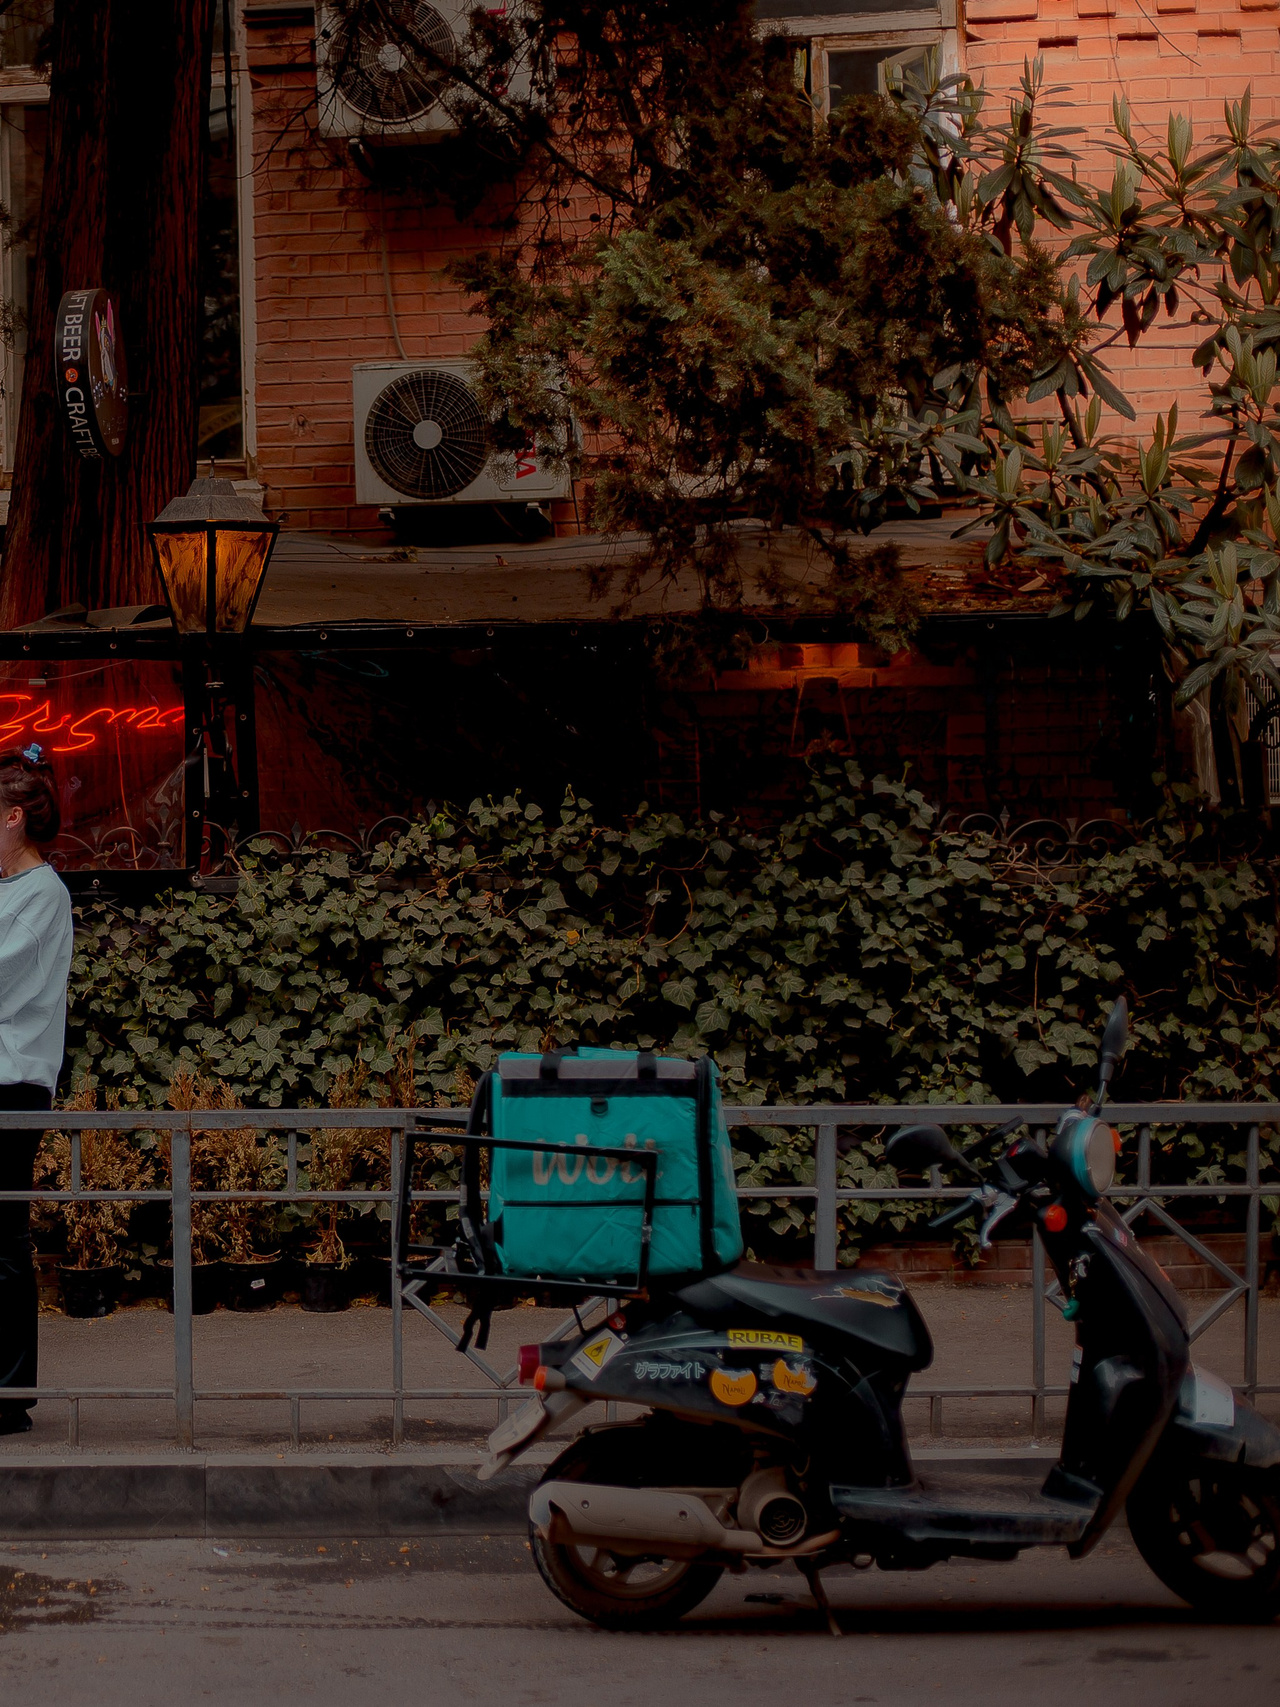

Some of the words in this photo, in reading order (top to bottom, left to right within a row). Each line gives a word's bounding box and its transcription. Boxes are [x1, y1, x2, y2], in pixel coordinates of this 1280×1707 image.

[62, 313, 84, 362] BEER
[65, 386, 95, 445] CRAFT
[634, 1361, 705, 1379] グラファイト
